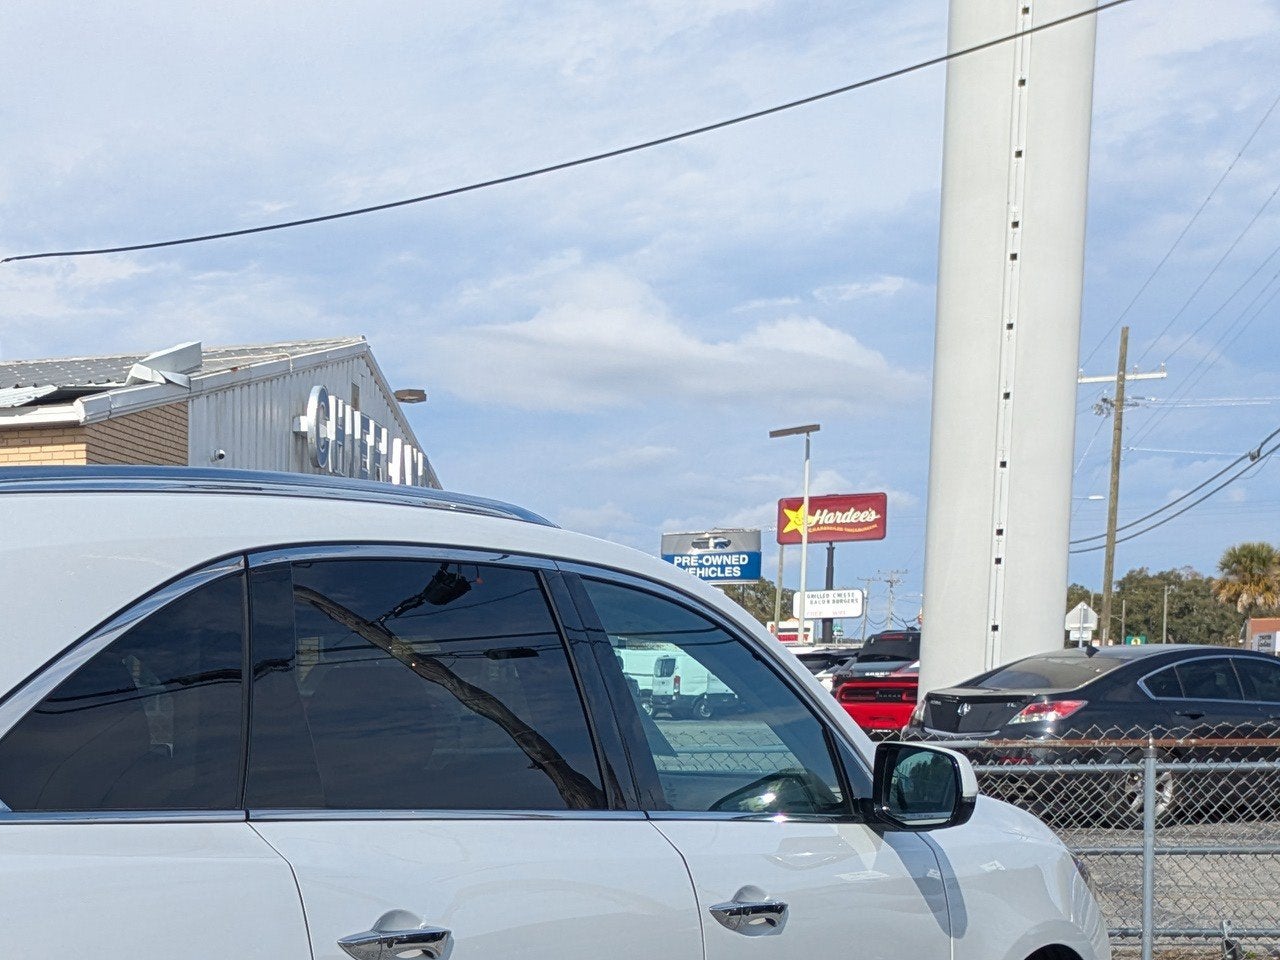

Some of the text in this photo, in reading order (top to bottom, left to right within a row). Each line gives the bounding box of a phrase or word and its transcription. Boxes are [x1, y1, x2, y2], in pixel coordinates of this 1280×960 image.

[808, 507, 881, 526] Hardee's
[674, 554, 748, 566] PRE-OWNED
[684, 566, 741, 577] EHICLES
